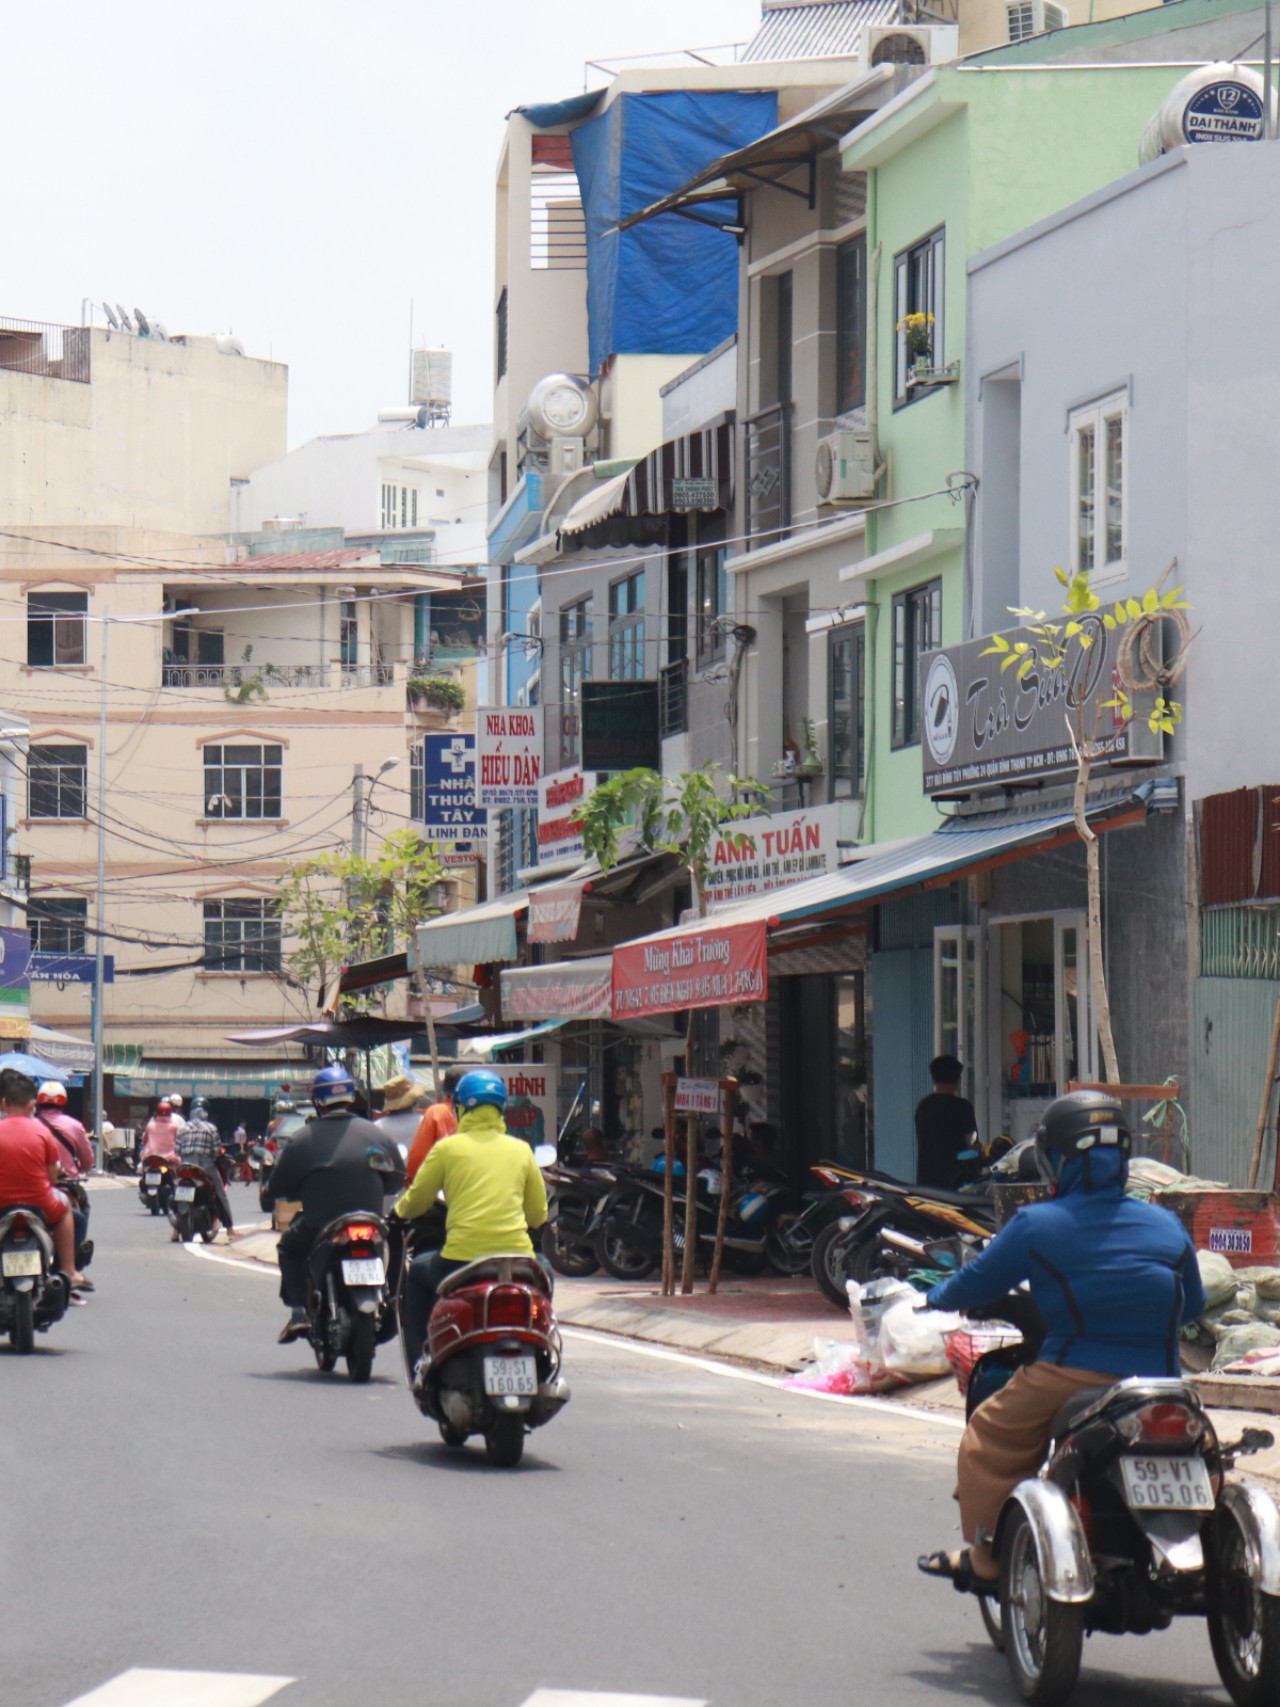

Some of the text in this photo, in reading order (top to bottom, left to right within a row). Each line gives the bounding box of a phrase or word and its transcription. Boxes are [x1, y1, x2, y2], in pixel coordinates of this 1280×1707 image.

[1221, 90, 1237, 101] 12
[486, 714, 535, 736] NHA KHOA
[481, 740, 540, 786] HIẾU DÂN
[428, 791, 475, 806] THUỐ
[441, 808, 474, 822] TÂY
[428, 827, 457, 839] LINH
[762, 815, 820, 857] TUẤN
[672, 940, 694, 968] Khai
[508, 1071, 546, 1097] HÌNH
[1132, 1484, 1208, 1505] 605.06
